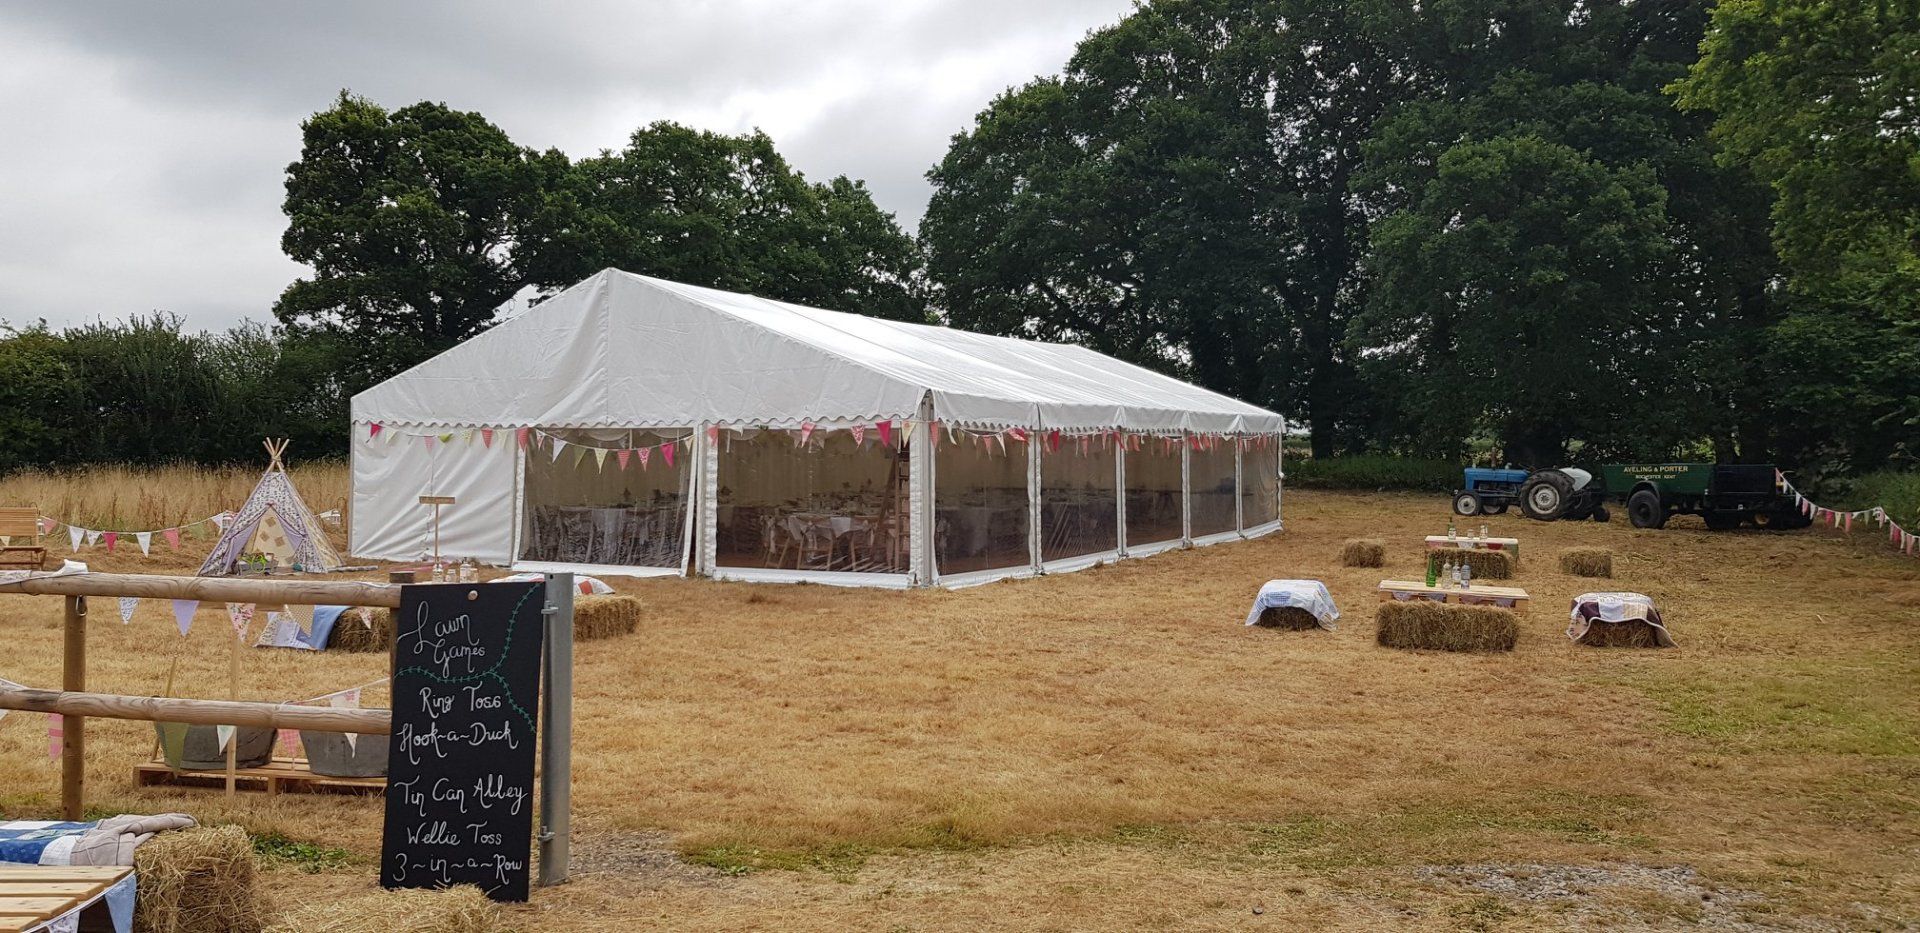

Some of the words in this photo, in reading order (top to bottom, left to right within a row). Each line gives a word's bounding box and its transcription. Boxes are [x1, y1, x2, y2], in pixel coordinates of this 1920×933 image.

[396, 600, 480, 655] Lawn
[433, 638, 486, 679] Games
[419, 686, 455, 719] Ring
[462, 680, 502, 712] Toss
[393, 774, 427, 817] Tin
[432, 777, 468, 814] Can
[472, 773, 528, 816] Alley
[406, 820, 461, 846] Wellie
[466, 820, 503, 846] Toss
